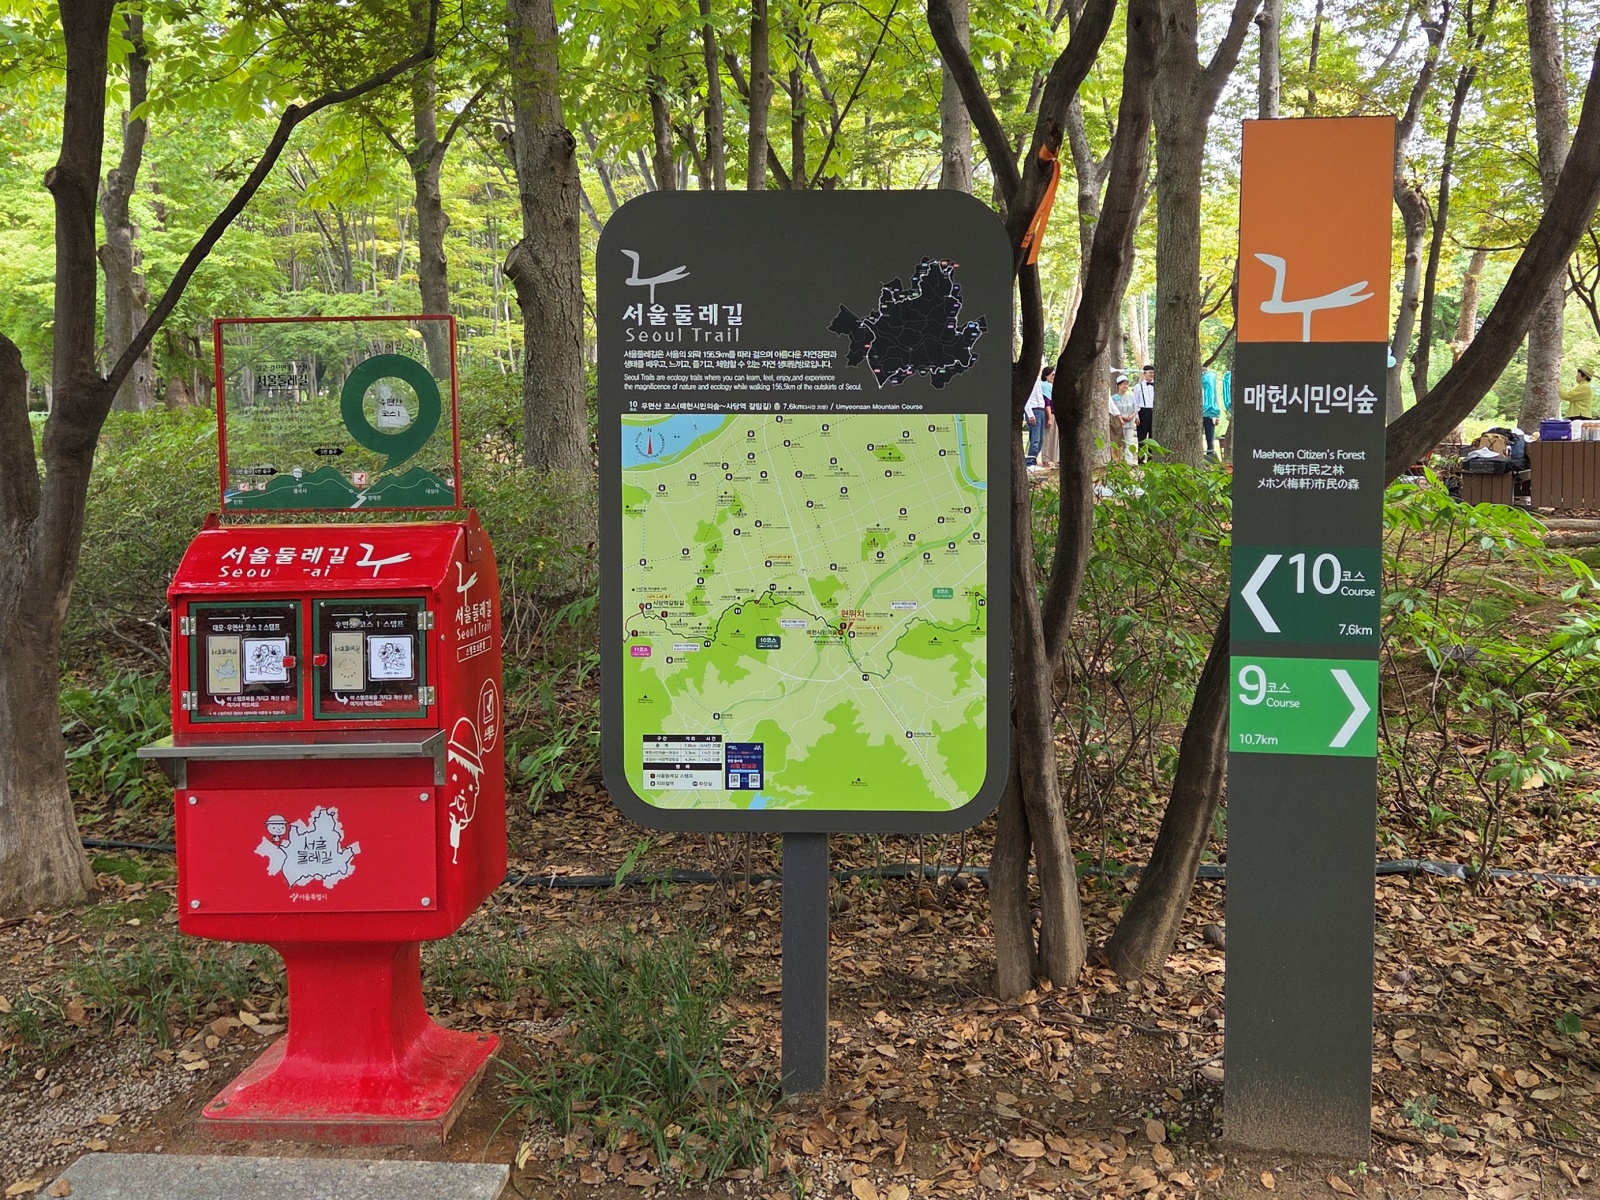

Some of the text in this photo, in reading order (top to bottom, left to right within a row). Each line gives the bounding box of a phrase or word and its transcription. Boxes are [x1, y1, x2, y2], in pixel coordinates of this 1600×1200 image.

[622, 303, 743, 326] 서울둘레길
[625, 327, 740, 342] Seoul Trail
[737, 360, 746, 369] 수
[256, 374, 309, 387] 서울둘레길
[667, 374, 689, 382] ecology
[722, 374, 733, 382] you
[804, 374, 836, 382] experience
[634, 383, 671, 391] magnificence
[710, 383, 733, 391] ecology
[749, 383, 771, 391] walking
[772, 383, 796, 391] 156.5km
[845, 383, 863, 391] Seoul.
[1244, 384, 1378, 414] 매헌시민의숲
[836, 403, 871, 411] Umyeonsan
[1252, 449, 1366, 460] Maeheon Citizen's Forest
[1272, 463, 1345, 476] 梅轩市民之林
[221, 546, 349, 565] 서울둘레길
[218, 565, 275, 578] Seou
[1288, 553, 1366, 595] 10 코스
[1341, 585, 1376, 597] Course
[455, 599, 492, 626] 서울둘레길
[841, 609, 865, 618] 현위치
[263, 623, 280, 631] 스탬프
[383, 620, 404, 628] 스탬프
[456, 619, 492, 641] Seoul Trail
[1338, 623, 1373, 636] 7.6km
[1238, 664, 1291, 706] 9 코스
[1266, 697, 1301, 709] Course
[1239, 733, 1279, 746] 10.7km
[304, 836, 327, 851] 서울
[297, 851, 333, 865] 둘레길
[299, 893, 328, 901] 서울특별시
